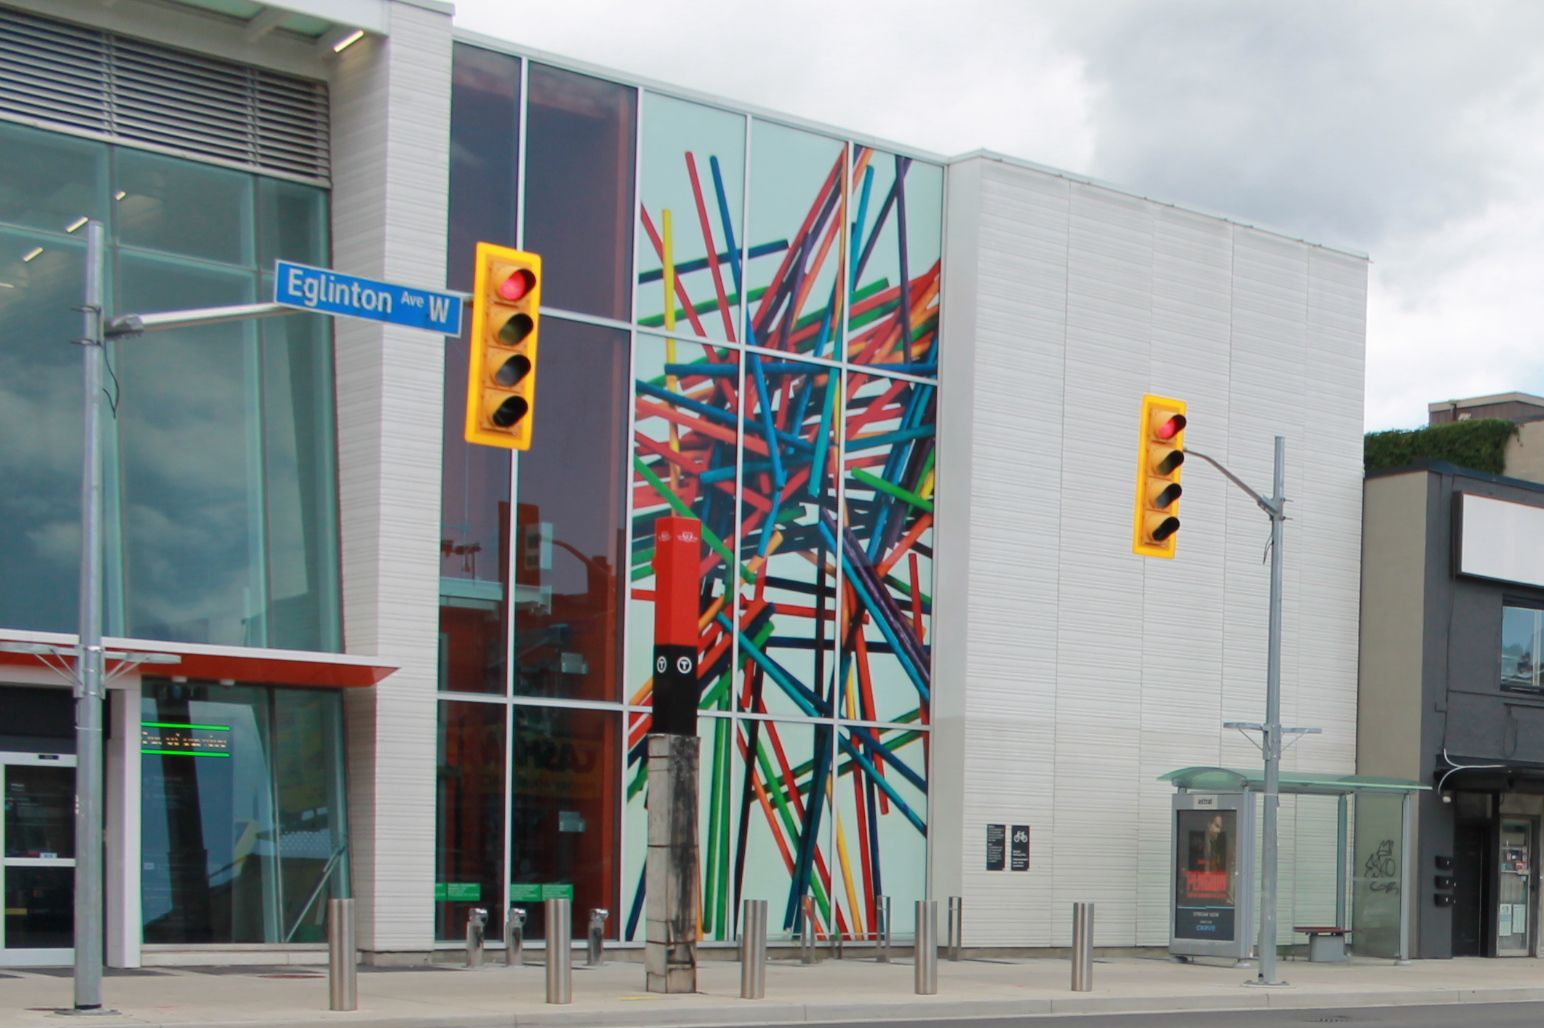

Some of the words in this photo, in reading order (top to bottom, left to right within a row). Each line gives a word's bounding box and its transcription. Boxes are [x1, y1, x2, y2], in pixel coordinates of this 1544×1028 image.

[288, 268, 393, 315] Eglinton
[401, 291, 424, 308] Ave
[429, 295, 450, 324] W
